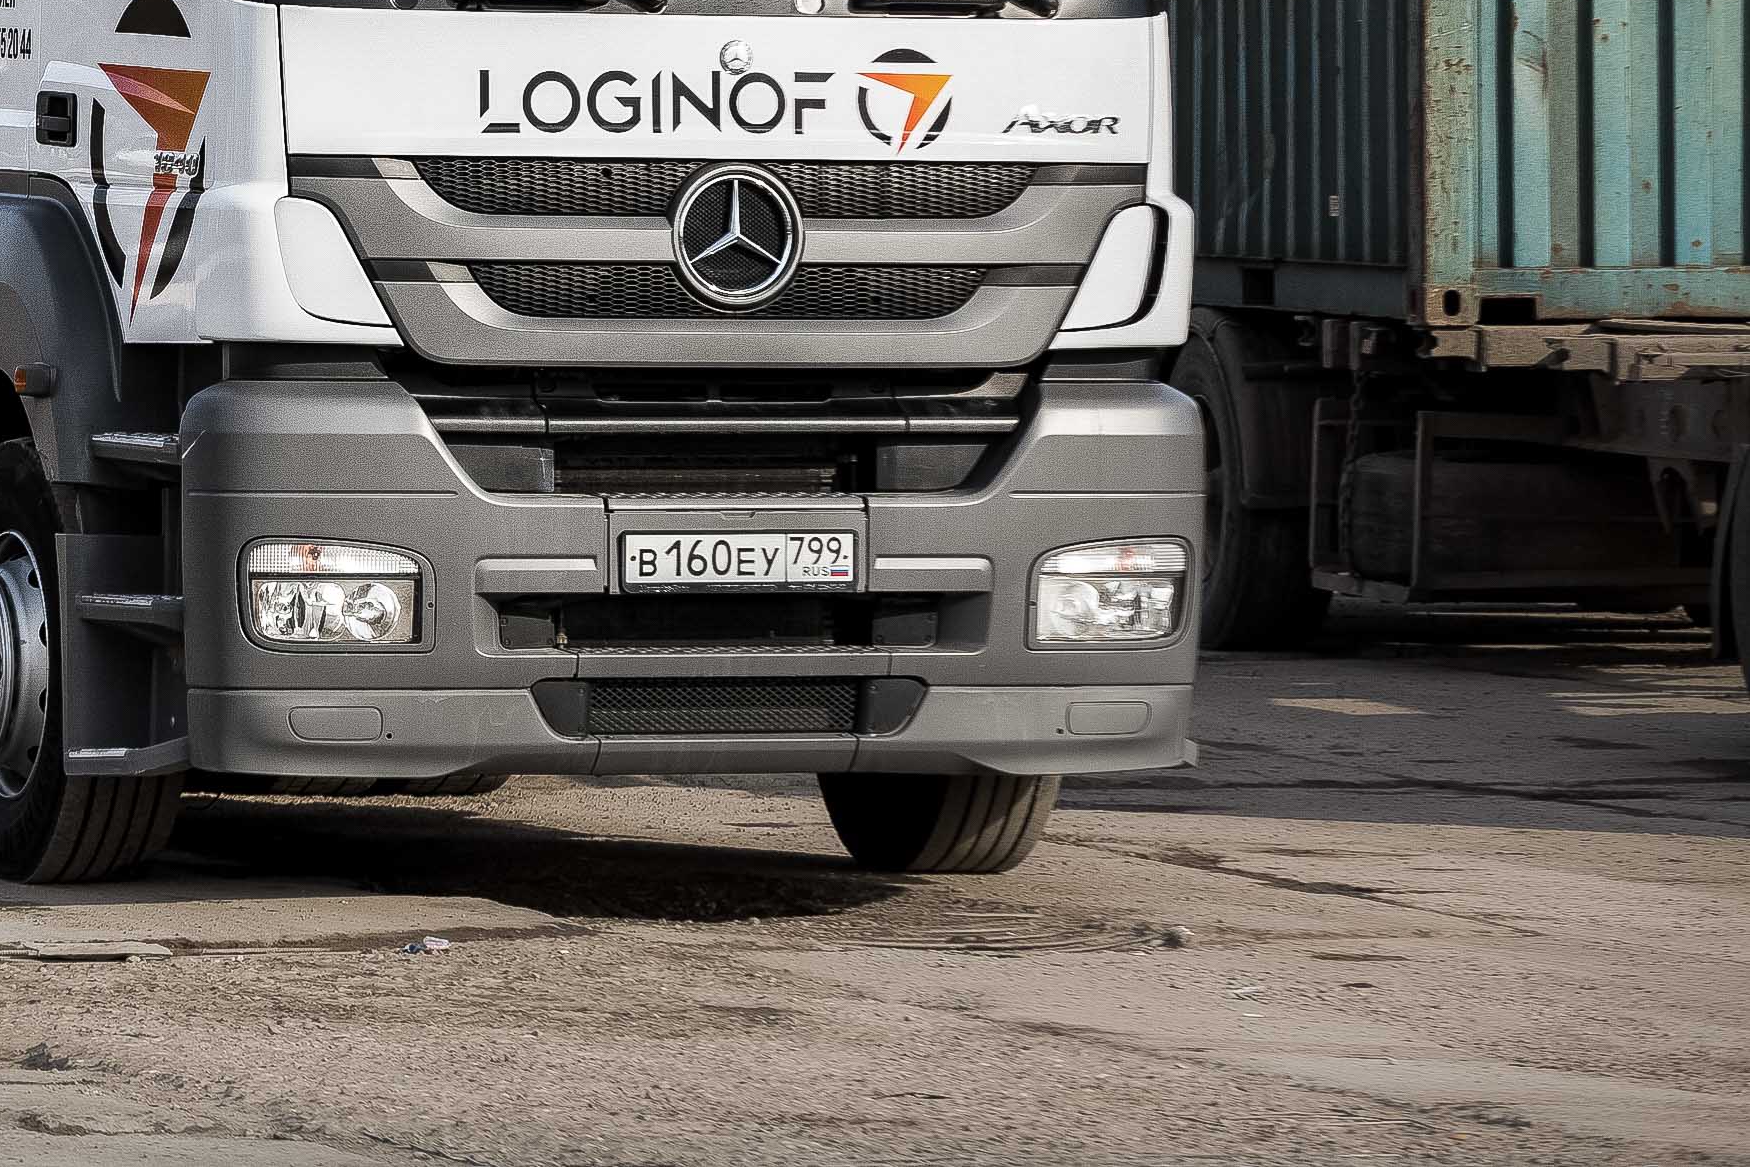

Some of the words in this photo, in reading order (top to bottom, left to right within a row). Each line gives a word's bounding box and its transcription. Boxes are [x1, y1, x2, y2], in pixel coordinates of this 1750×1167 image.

[7, 29, 18, 59] 20
[20, 29, 32, 59] 44
[479, 70, 836, 134] LOGINOF
[789, 537, 842, 565] 799
[802, 566, 830, 577] RUS
